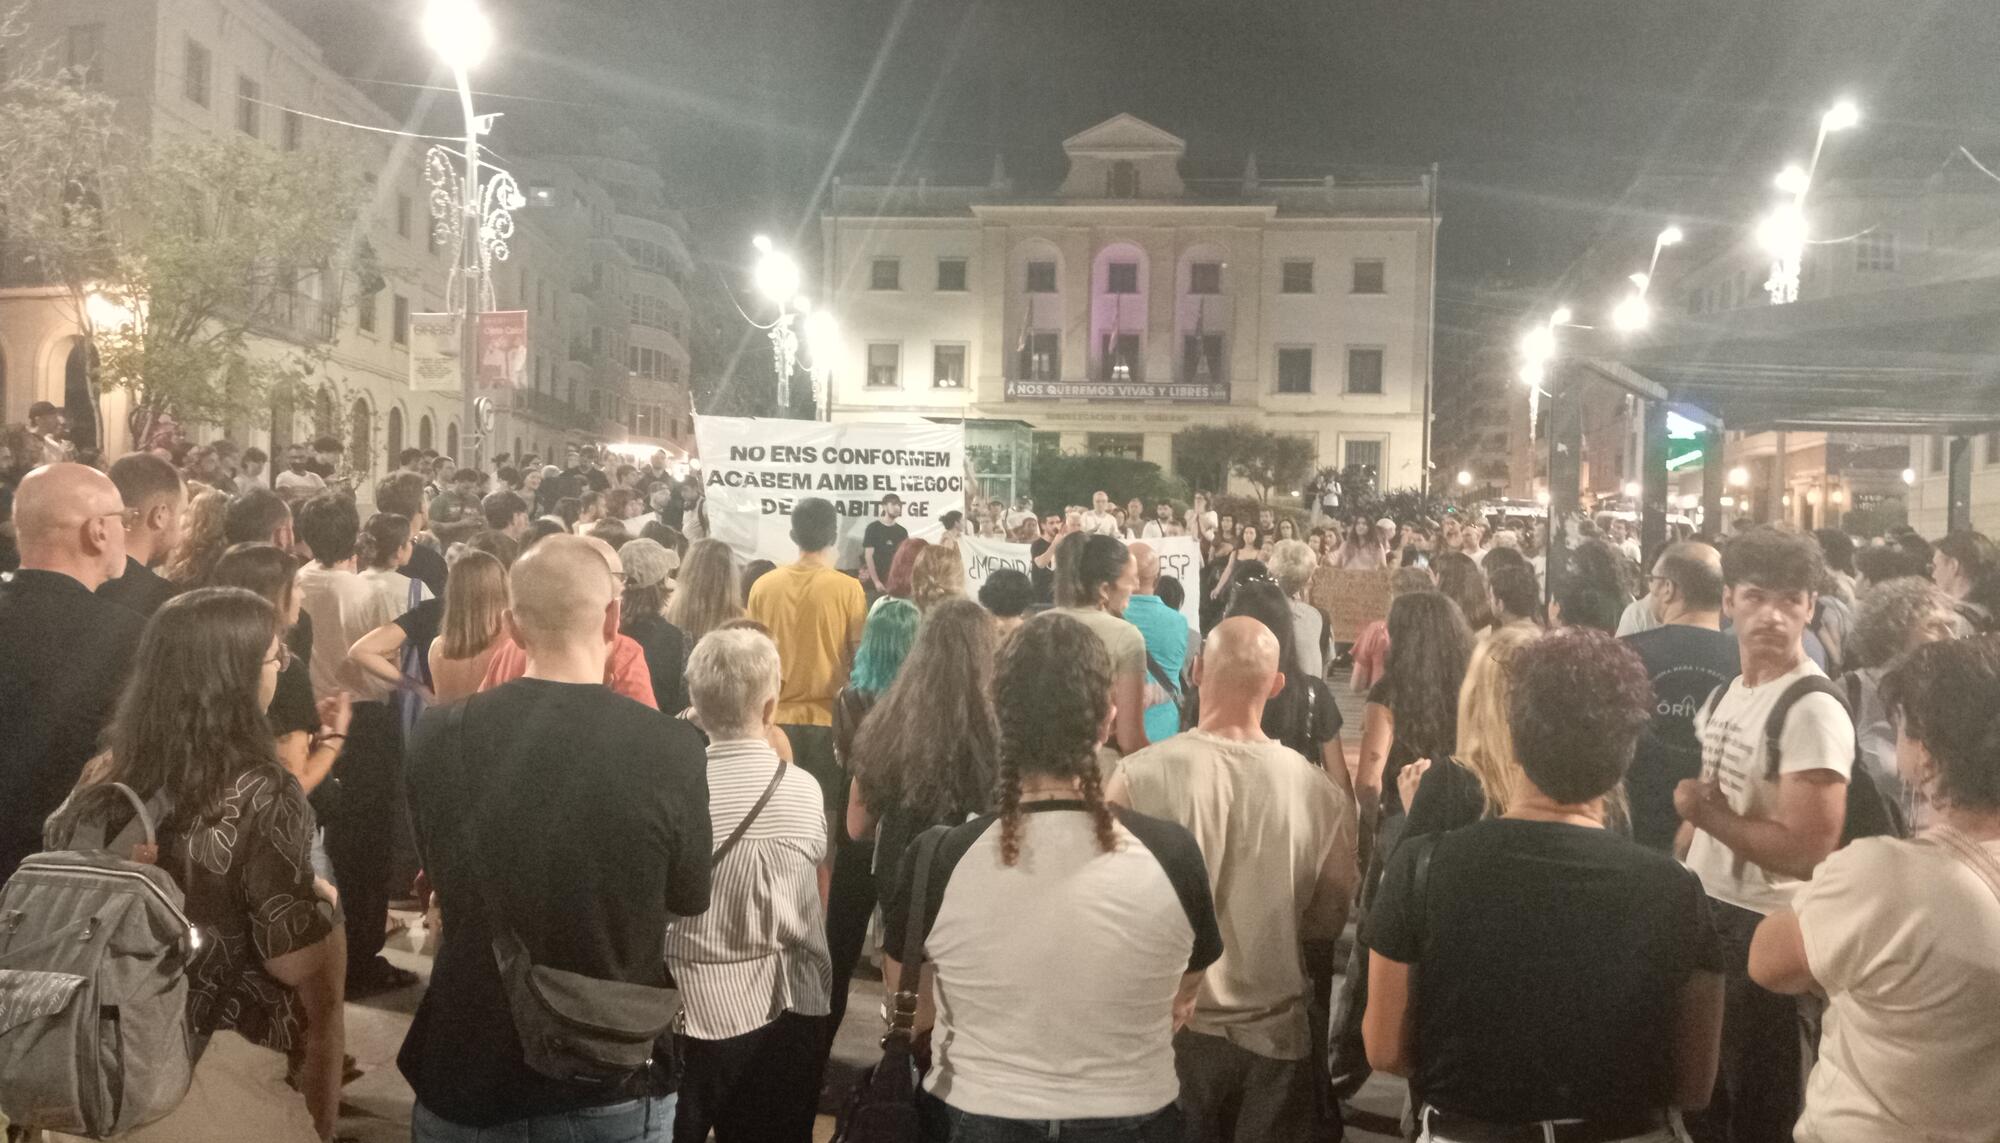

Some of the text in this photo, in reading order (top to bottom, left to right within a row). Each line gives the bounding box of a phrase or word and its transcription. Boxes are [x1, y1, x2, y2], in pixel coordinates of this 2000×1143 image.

[1017, 384, 1044, 394] NOS
[1046, 384, 1114, 396] QUEREMOS
[1118, 386, 1155, 397] VIVAS
[1158, 386, 1166, 396] Y
[1169, 386, 1209, 397] LIBRES
[730, 445, 950, 467] NO ENS CONFORMEM
[706, 469, 963, 493] ACABEM AMB EL NEGOCI
